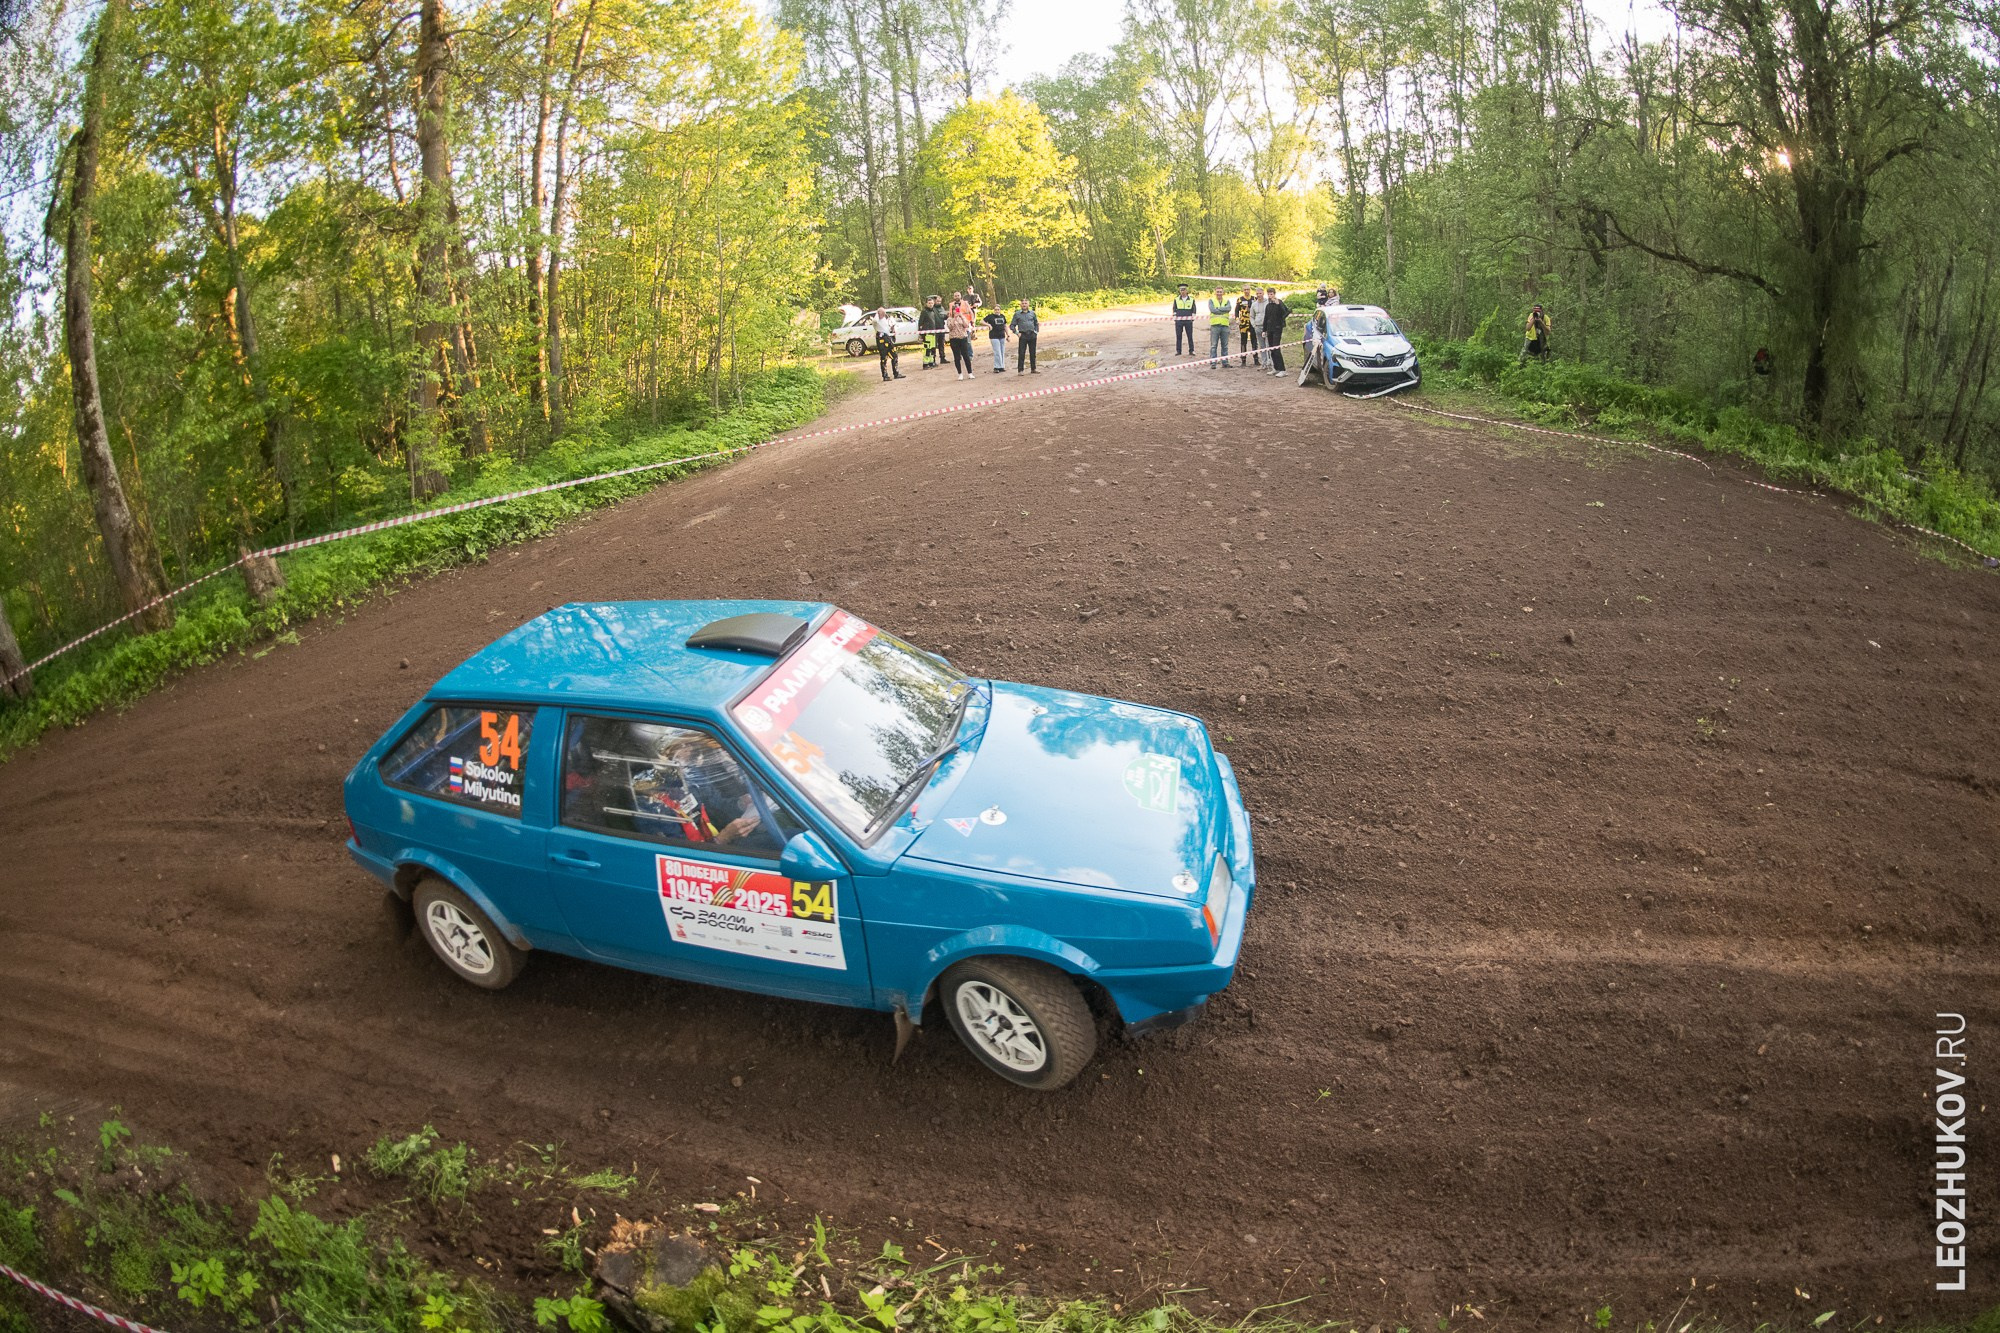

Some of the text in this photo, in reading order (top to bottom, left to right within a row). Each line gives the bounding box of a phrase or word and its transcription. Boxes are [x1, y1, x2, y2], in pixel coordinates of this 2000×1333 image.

[762, 659, 820, 713] РАЛЛИ
[479, 711, 521, 770] 54
[772, 731, 825, 774] 54
[465, 761, 514, 785] Sokolov
[464, 780, 521, 806] Milyutina
[666, 860, 729, 883] 80 ПОБЕДА!
[667, 878, 788, 917] 1945 2025
[792, 881, 834, 921] 54
[697, 917, 755, 934] РОССИИ
[698, 909, 746, 924] РАЛЛИ
